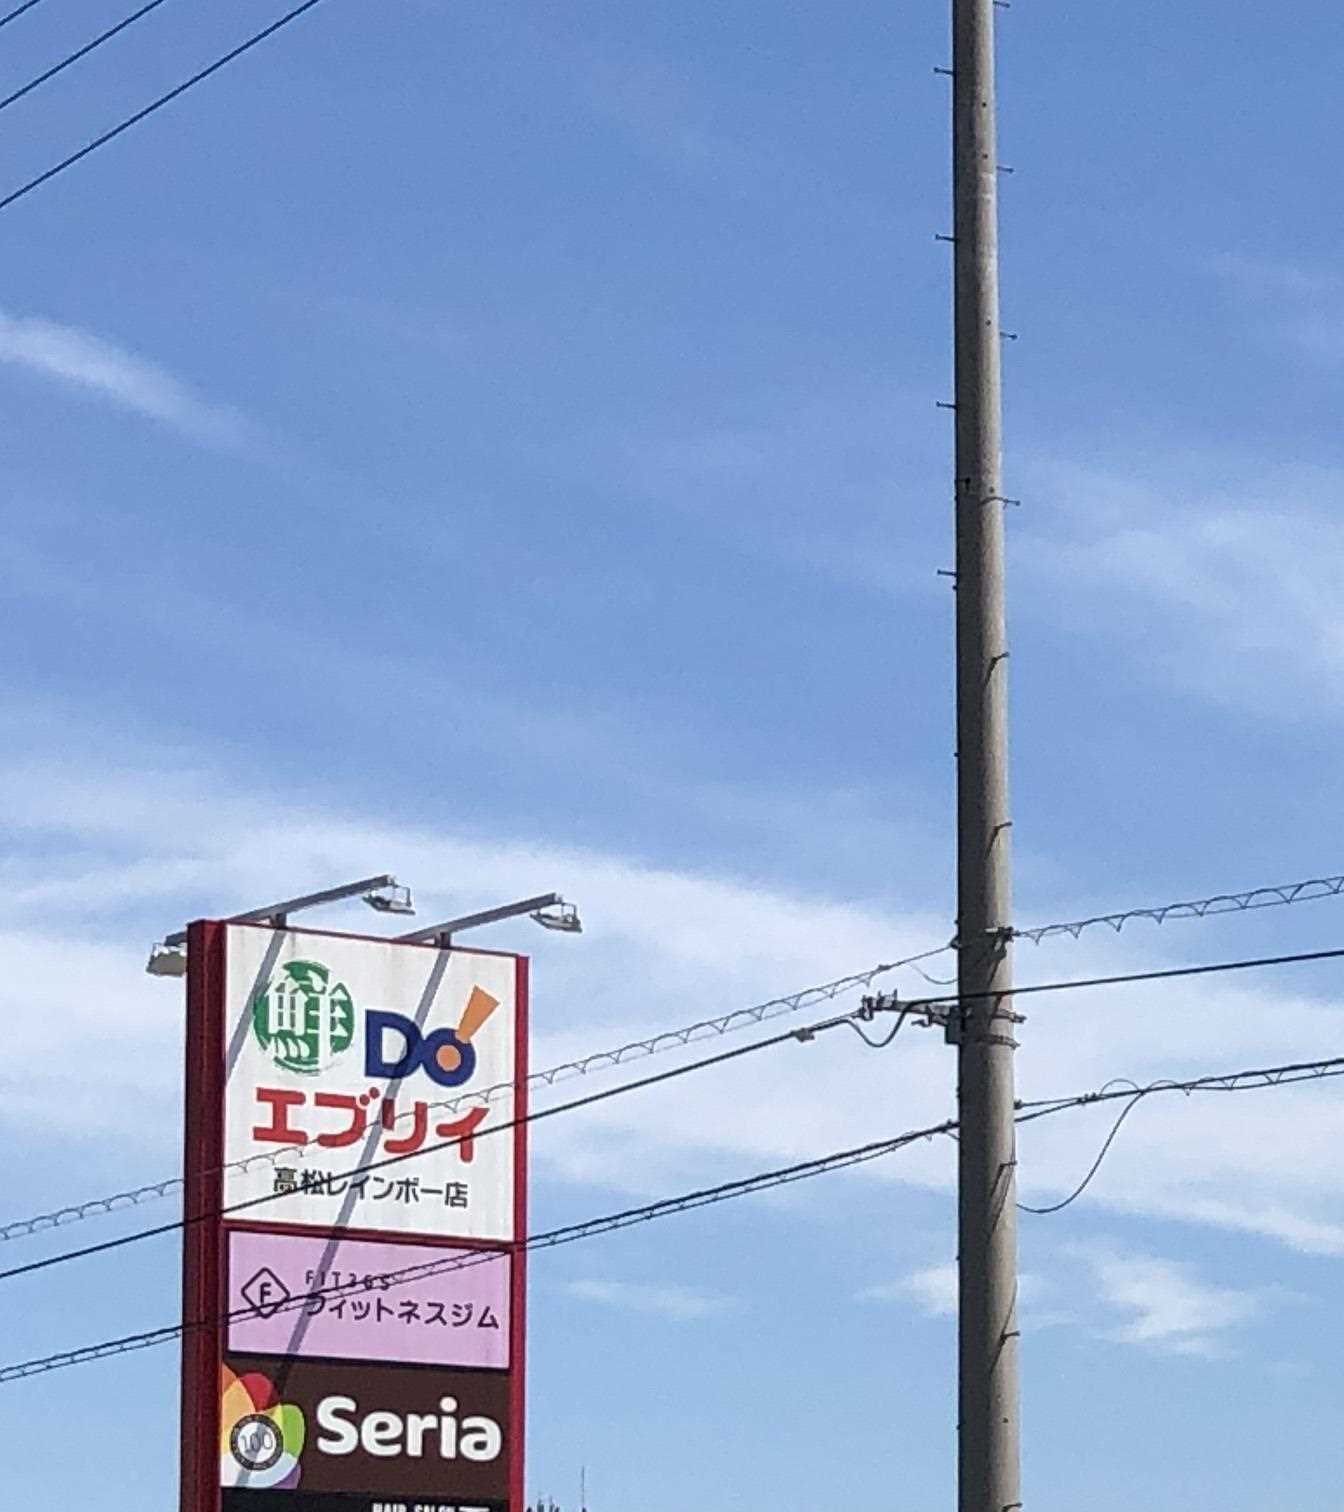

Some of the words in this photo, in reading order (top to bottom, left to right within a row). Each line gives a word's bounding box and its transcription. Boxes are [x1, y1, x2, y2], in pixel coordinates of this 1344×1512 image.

[252, 1086, 491, 1163] エブリイ
[273, 1166, 469, 1209] 高松レインボー店
[306, 1294, 500, 1329] フィットネスジム
[316, 1396, 502, 1462] Seria
